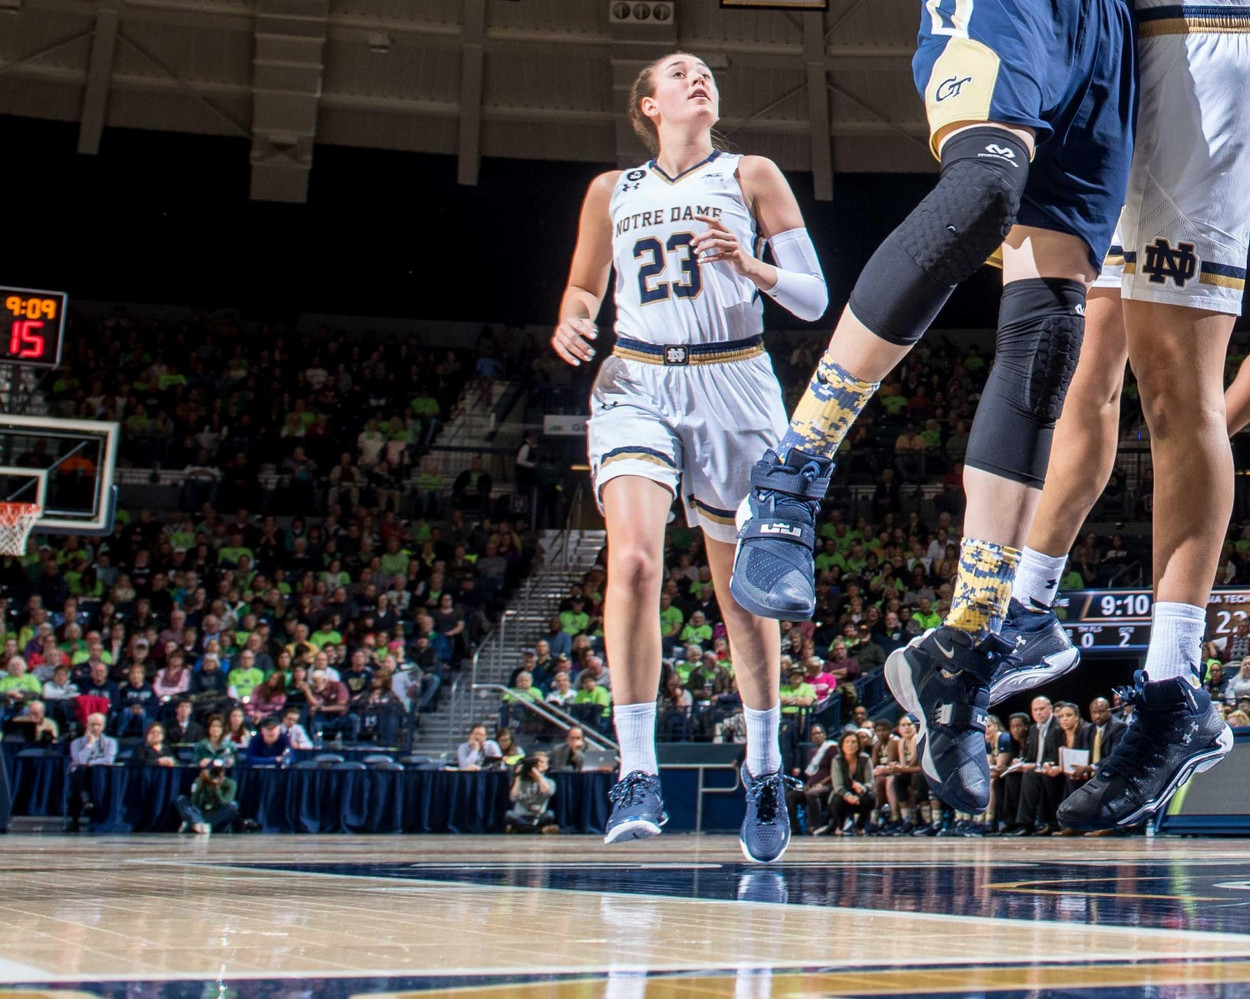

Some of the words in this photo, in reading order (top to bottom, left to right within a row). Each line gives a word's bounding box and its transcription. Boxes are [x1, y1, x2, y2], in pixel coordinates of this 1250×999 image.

[616, 208, 664, 239] NOTRE
[670, 204, 723, 223] DAME
[632, 230, 704, 307] 23
[6, 296, 57, 320] 9:09
[9, 320, 45, 358] 15
[1101, 594, 1150, 616] 9:10
[1224, 594, 1250, 603] TECH
[1081, 632, 1094, 648] 0
[1119, 632, 1131, 648] 2
